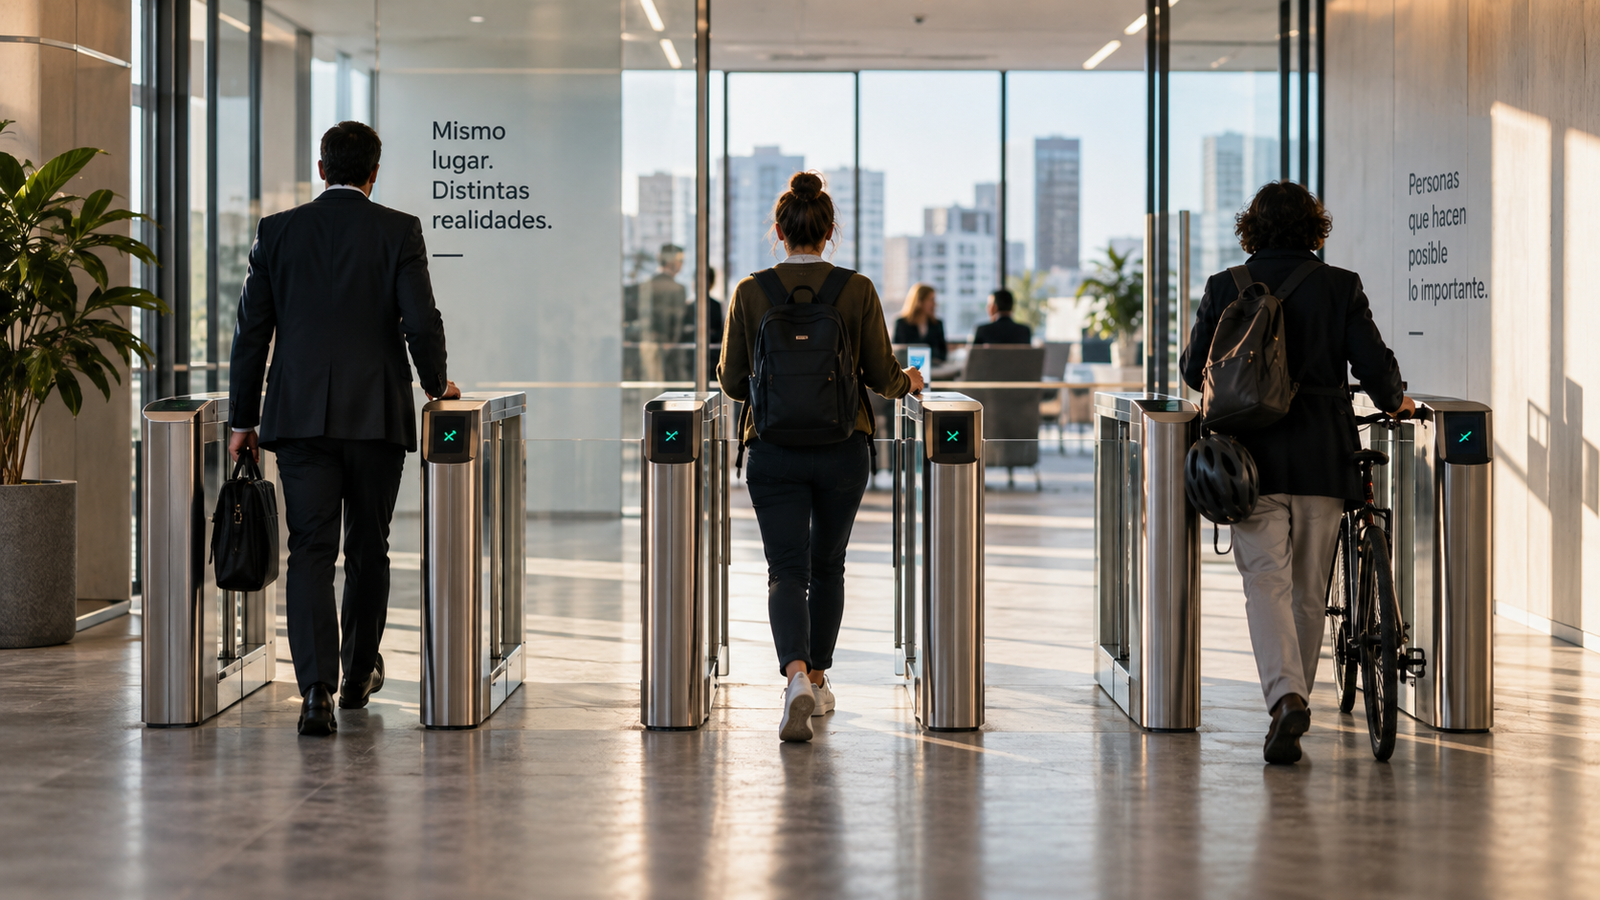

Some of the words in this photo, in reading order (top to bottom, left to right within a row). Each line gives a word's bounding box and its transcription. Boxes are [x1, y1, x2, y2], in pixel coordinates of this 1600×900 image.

[432, 120, 506, 141] Mismo
[432, 149, 494, 175] lugar.
[432, 180, 530, 200] Distintas
[1408, 170, 1460, 196] Personas
[432, 209, 553, 230] realidades.
[1408, 212, 1430, 236] que
[1431, 203, 1467, 229] hacen
[1408, 239, 1448, 272] posible
[1408, 278, 1419, 302] lo
[1420, 276, 1489, 307] importante.
